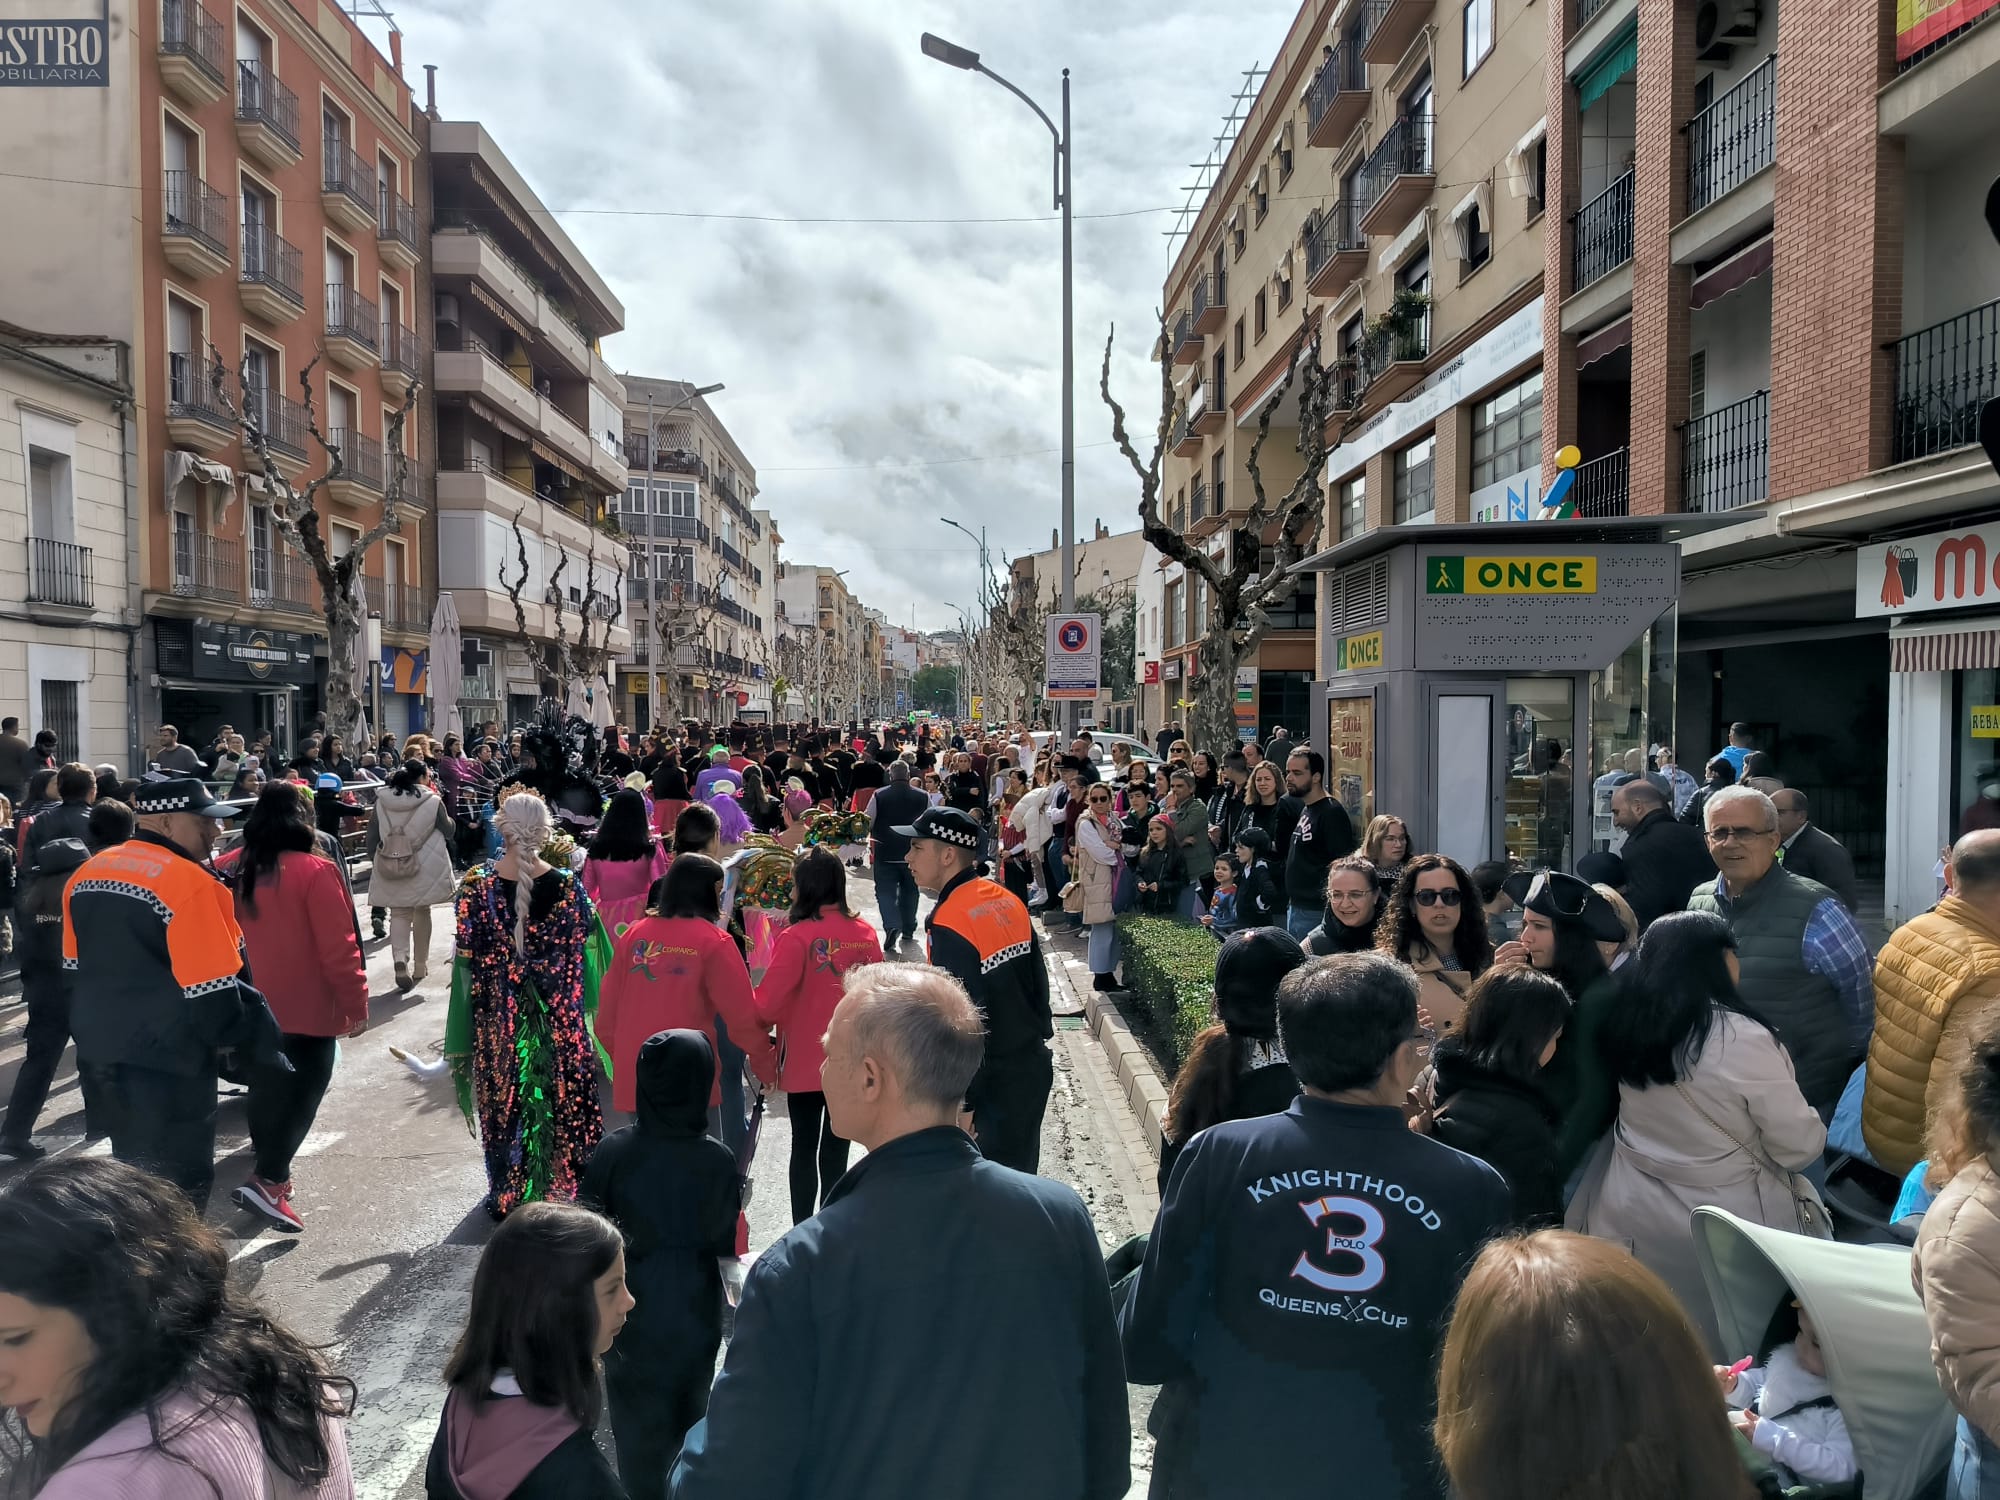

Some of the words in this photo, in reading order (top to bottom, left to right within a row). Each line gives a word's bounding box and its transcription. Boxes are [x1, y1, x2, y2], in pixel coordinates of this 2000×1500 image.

[0, 26, 103, 66] STRO
[1478, 562, 1584, 588] ONCE
[1350, 637, 1379, 664] ONCE
[1247, 1169, 1441, 1231] KNIGHTHOOD
[1290, 1195, 1386, 1292] 3
[1334, 1237, 1365, 1250] POLO
[1258, 1288, 1342, 1316] QUEENS
[1363, 1305, 1408, 1329] CUP
